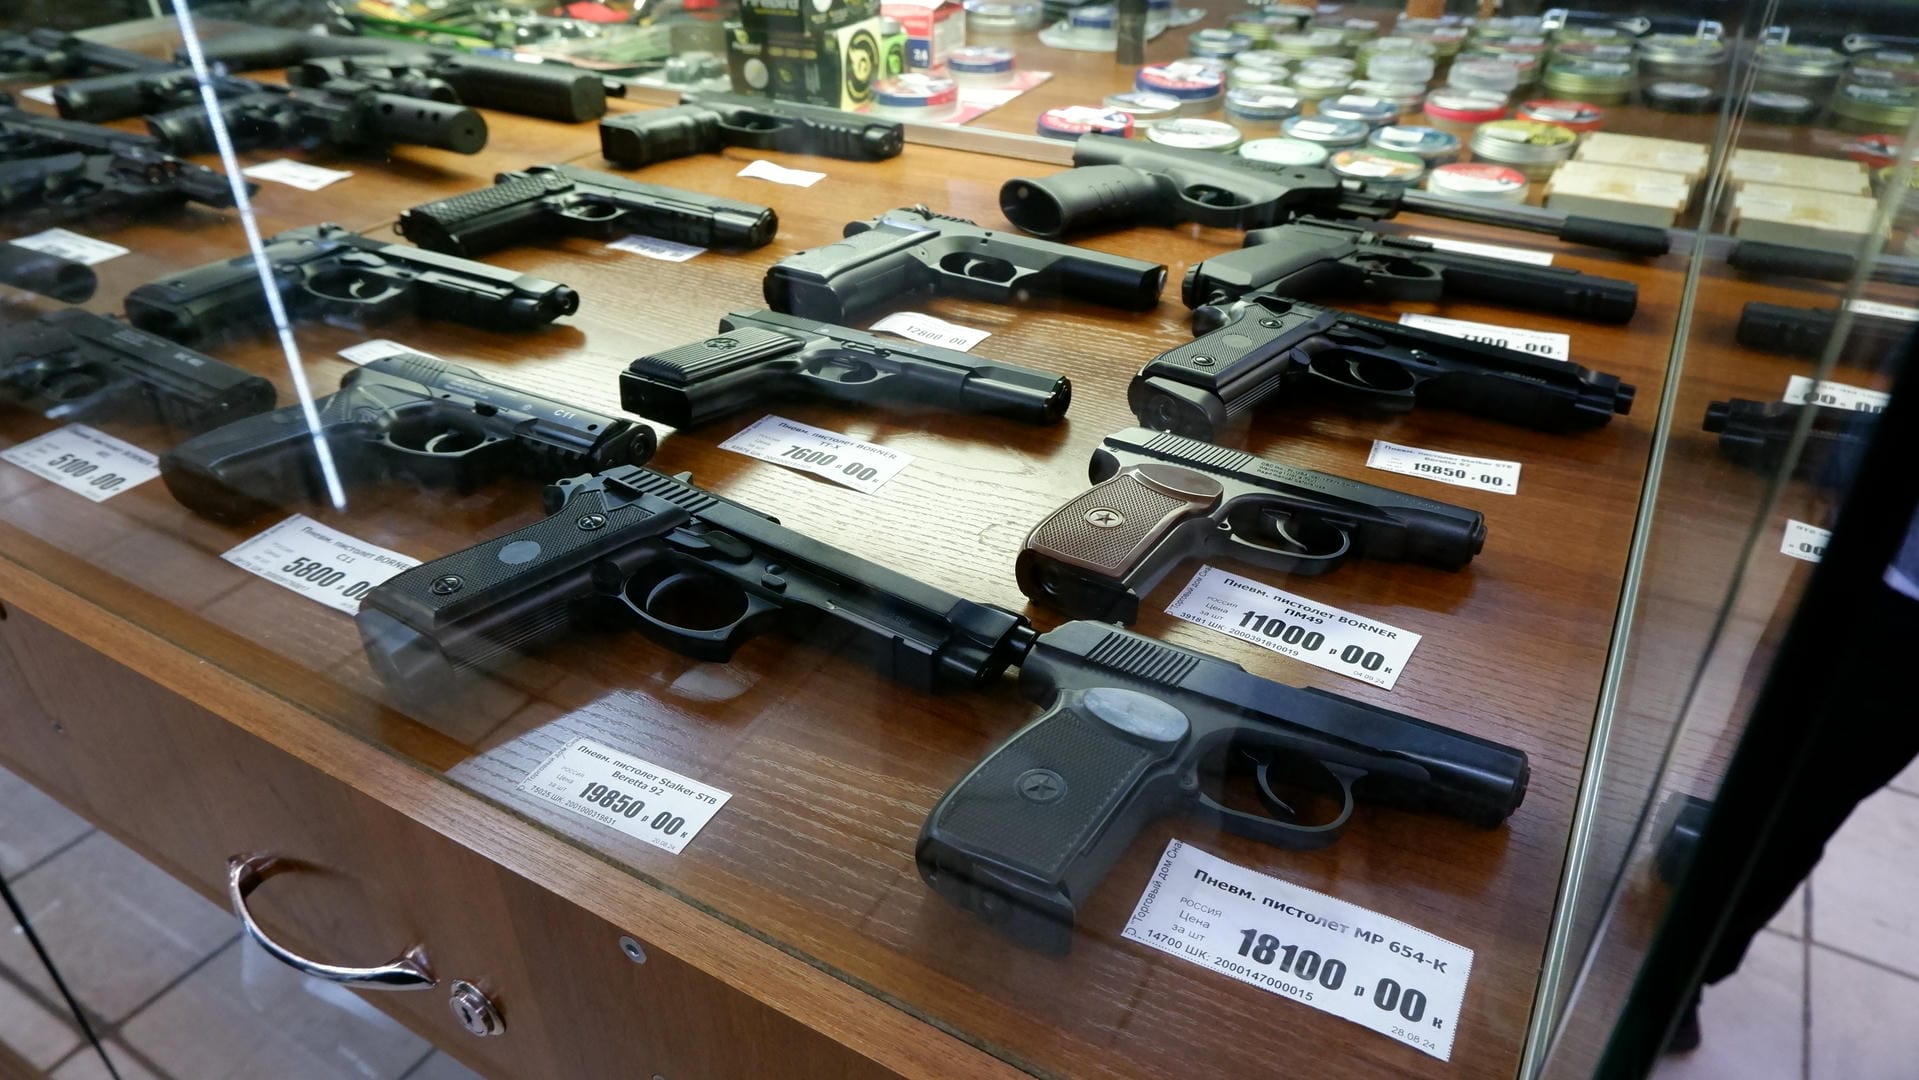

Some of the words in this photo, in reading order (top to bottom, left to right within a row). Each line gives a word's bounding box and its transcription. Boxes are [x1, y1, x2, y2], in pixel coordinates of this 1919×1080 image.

[1524, 342, 1554, 355] 00
[553, 409, 577, 420] C11
[48, 453, 98, 478] 5100
[90, 473, 127, 491] 00
[781, 444, 838, 466] 7600
[842, 462, 878, 481] 00
[1413, 462, 1467, 479] 19850
[1480, 474, 1503, 486] 00
[282, 556, 347, 588] 5800
[1223, 577, 1269, 598] Пневм.
[1273, 594, 1336, 620] пистолет
[1338, 616, 1398, 640] BORNER
[1283, 607, 1325, 625] ПМ49
[1179, 611, 1207, 625] 39181
[1228, 627, 1300, 657] 2000391810019
[1236, 610, 1326, 652] 11000
[1340, 644, 1386, 672] 00
[577, 745, 611, 763] Пневм.
[612, 759, 660, 782] пистолет
[660, 776, 696, 797] Stalker
[694, 792, 718, 805] STB
[611, 770, 649, 790] Beretta
[649, 786, 665, 797] 92
[578, 781, 646, 819] 19850
[650, 810, 687, 836] 00
[1194, 868, 1257, 902] Пневм.
[1262, 896, 1350, 933] пистолет
[1170, 923, 1188, 935] за
[1189, 929, 1207, 943] шт
[1178, 910, 1211, 930] Цена
[1146, 928, 1183, 950] 14700
[1214, 956, 1315, 1002] 2000147000015
[1236, 928, 1348, 992] 18100
[1373, 976, 1428, 1024] 00
[1390, 1025, 1437, 1051] 28.08.24
